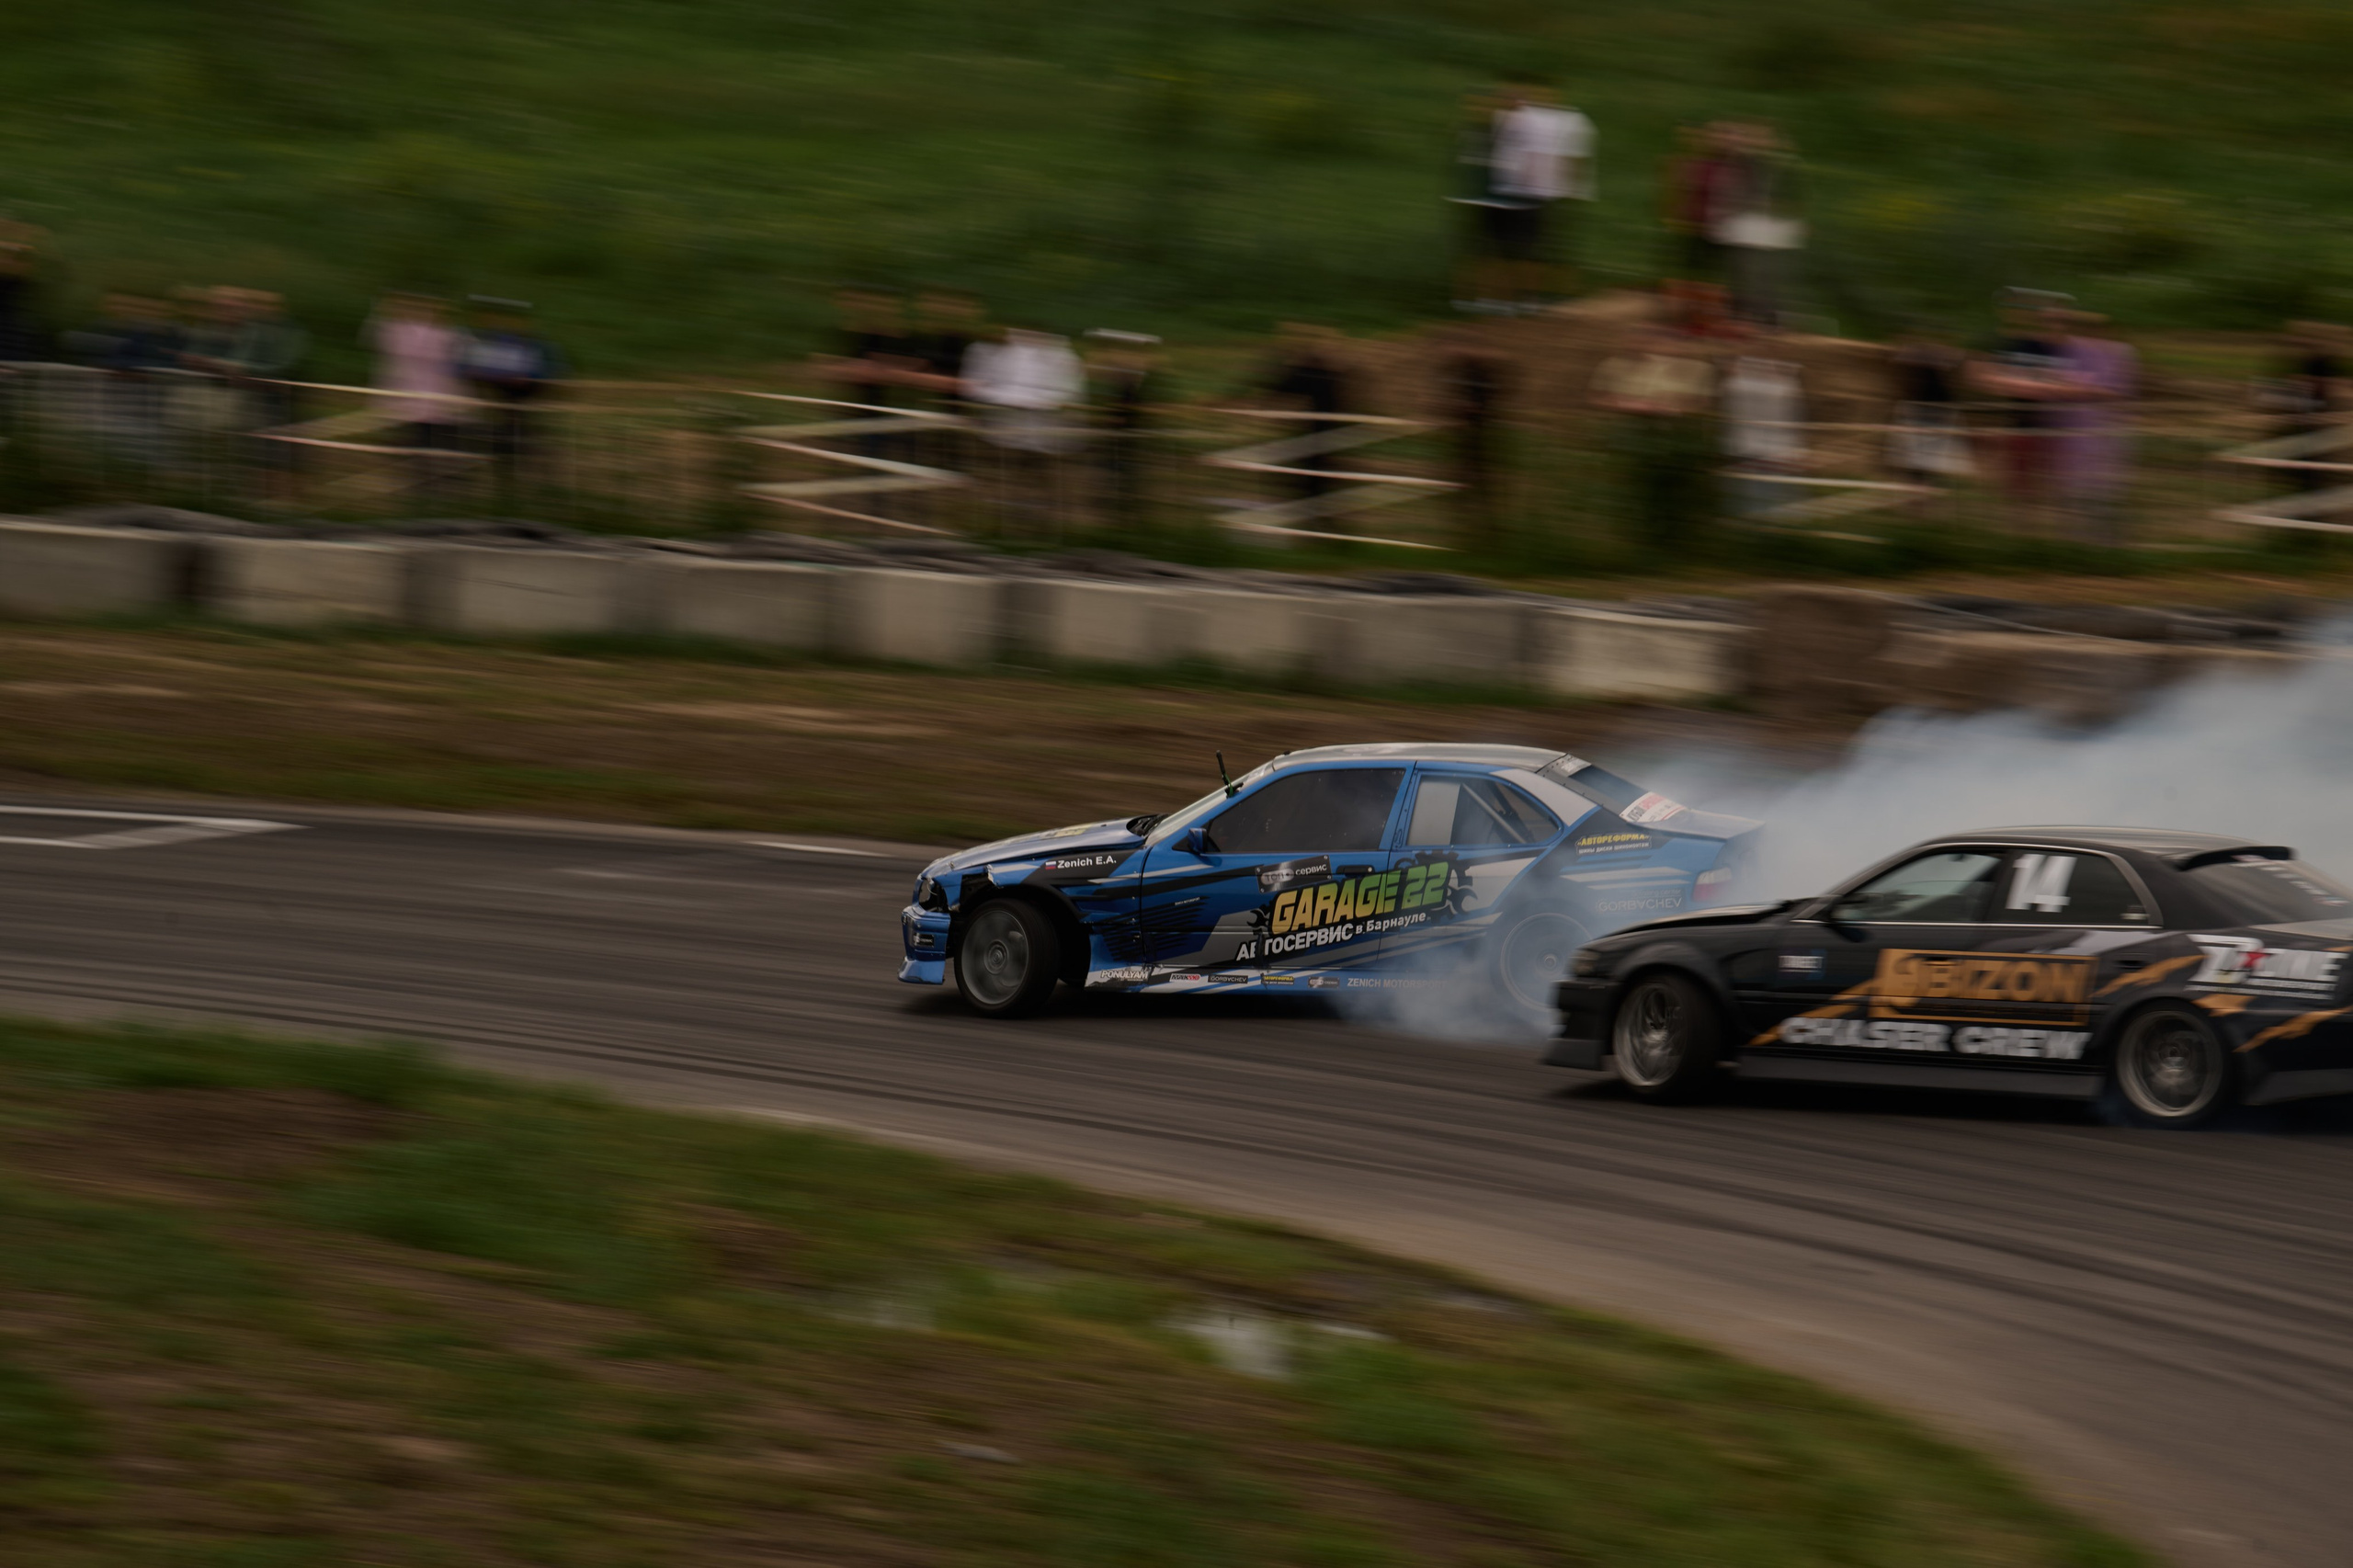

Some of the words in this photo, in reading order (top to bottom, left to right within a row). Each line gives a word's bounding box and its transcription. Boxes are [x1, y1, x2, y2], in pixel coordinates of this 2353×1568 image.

[1057, 858, 1093, 869] Zenich
[1096, 855, 1117, 866] E.A.
[1295, 864, 1327, 876] сервис
[2006, 853, 2077, 913] 14
[1270, 869, 1401, 936] GARAGE
[1401, 861, 1449, 910] 22
[1366, 912, 1427, 932] Барнауле
[1347, 978, 1381, 988] ZENICH
[1778, 1017, 1952, 1052] CHASER
[1952, 1026, 2094, 1060] CREW
